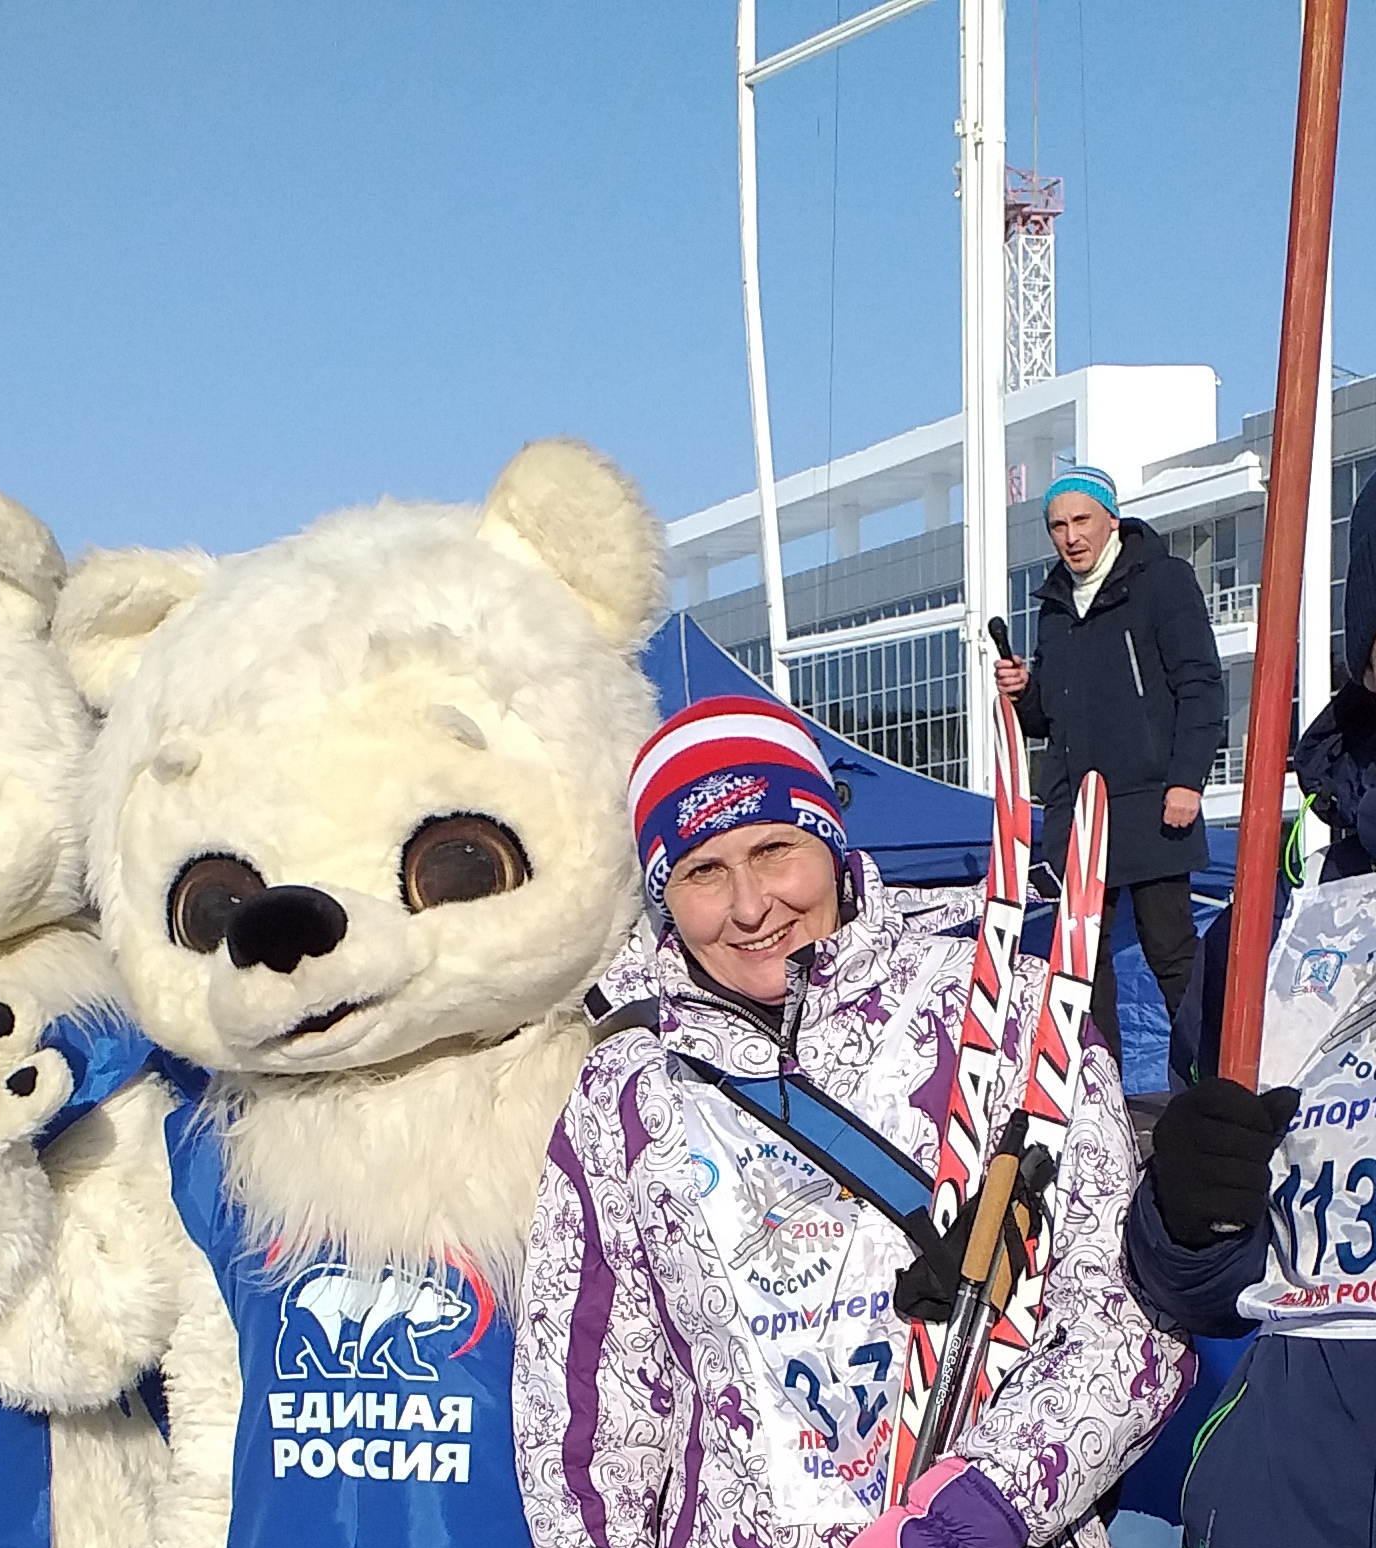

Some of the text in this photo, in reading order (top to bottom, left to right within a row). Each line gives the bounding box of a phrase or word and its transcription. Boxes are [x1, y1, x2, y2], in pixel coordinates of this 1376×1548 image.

[735, 1143, 817, 1177] ЫЖНЯ
[791, 1221, 845, 1240] 2019
[746, 1256, 833, 1297] РОССИИ
[268, 1391, 474, 1434] ЕДИНАЯ
[272, 1437, 471, 1483] РОССИЯ
